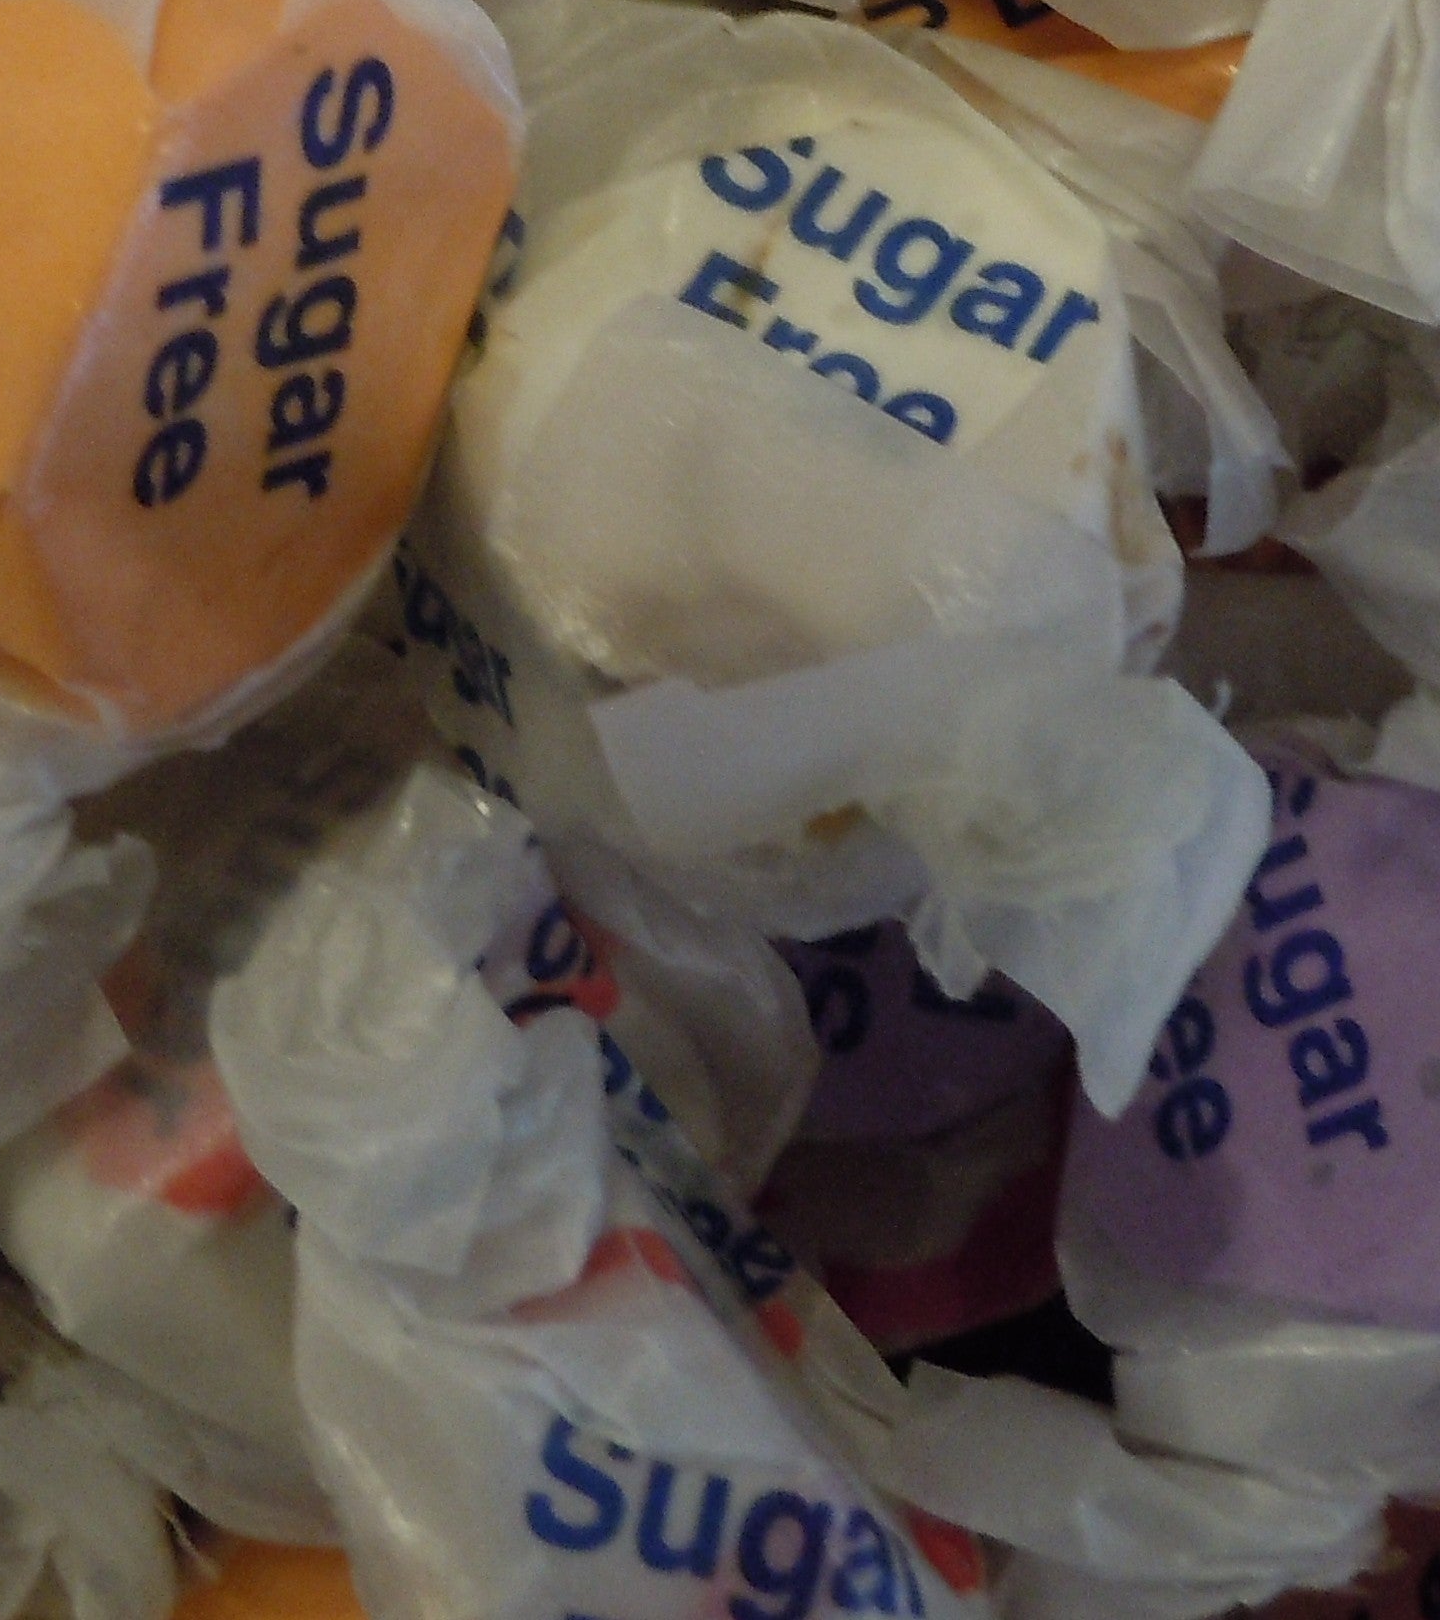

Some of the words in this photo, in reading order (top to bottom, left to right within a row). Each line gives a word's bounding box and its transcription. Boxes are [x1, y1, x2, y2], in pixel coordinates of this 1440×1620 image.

[133, 158, 260, 507] Free
[257, 56, 394, 502] Sugar
[698, 134, 1100, 365] Sugar
[1150, 994, 1233, 1162] ee
